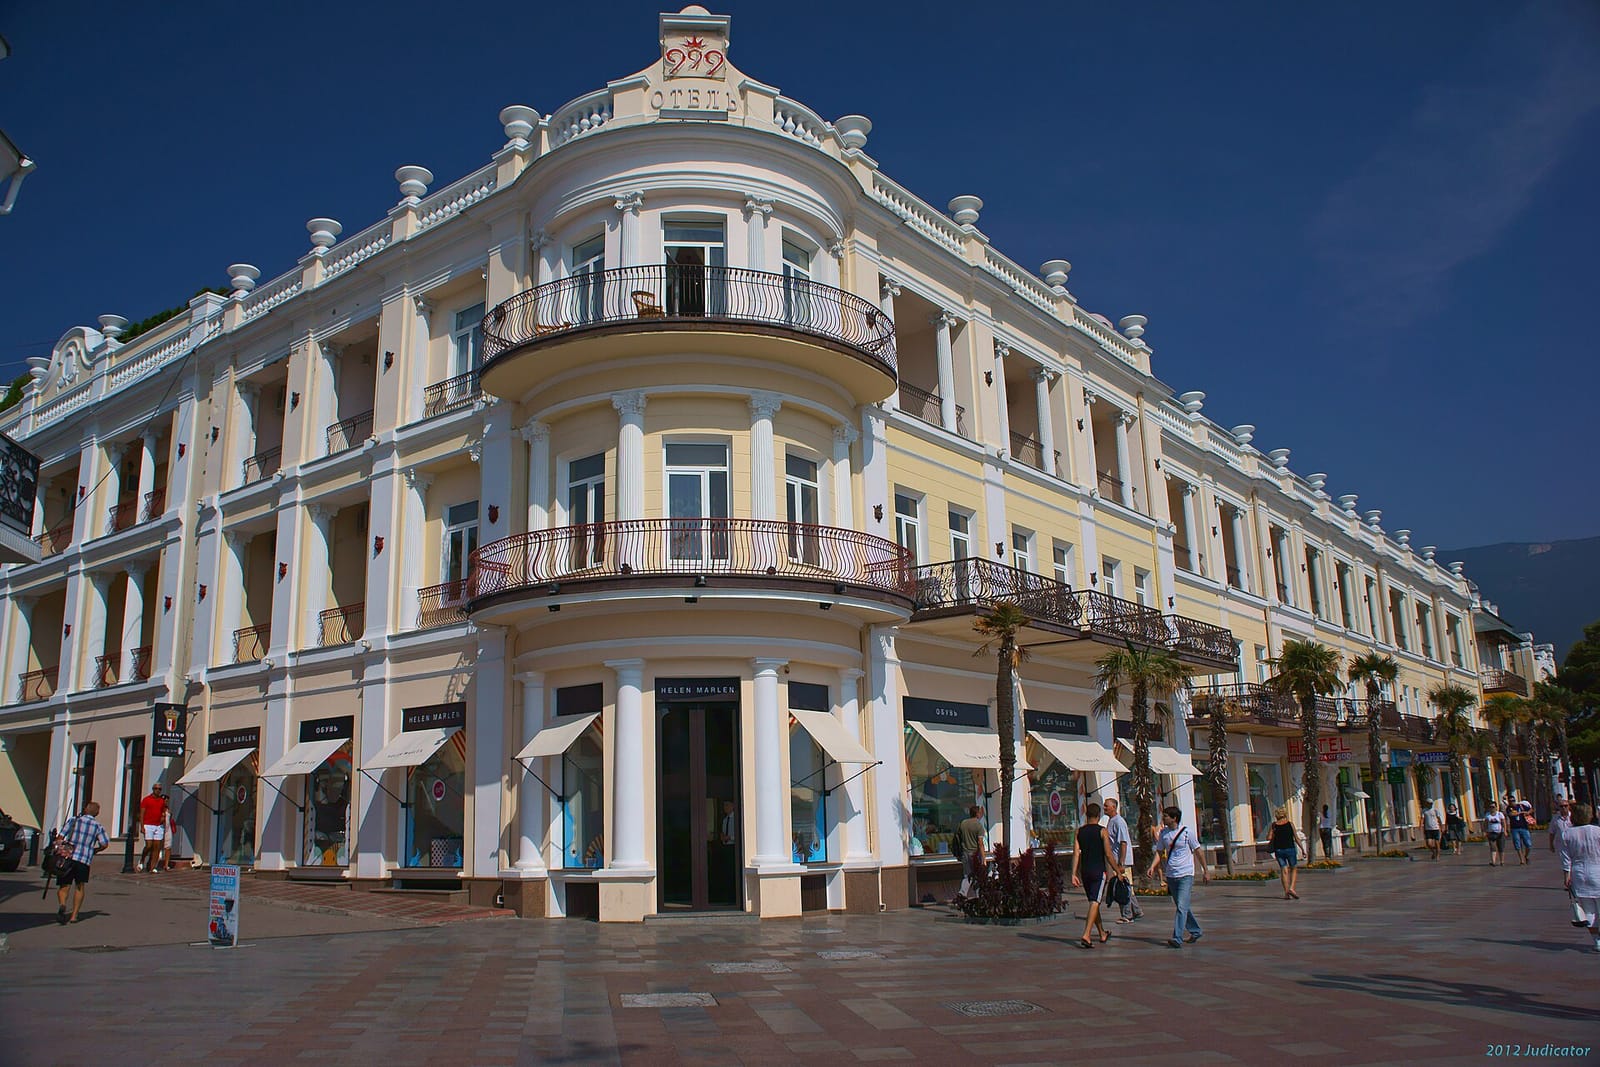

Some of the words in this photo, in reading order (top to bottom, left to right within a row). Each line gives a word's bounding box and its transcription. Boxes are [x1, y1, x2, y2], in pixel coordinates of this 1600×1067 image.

[665, 48, 724, 76] 999
[651, 88, 738, 112] ОТЕЛЬ
[661, 686, 691, 694] HELEN
[696, 686, 736, 694] MARLEN
[409, 714, 430, 724] HELEN
[315, 725, 339, 735] ОБУВЬ
[1289, 737, 1351, 754] HTEL
